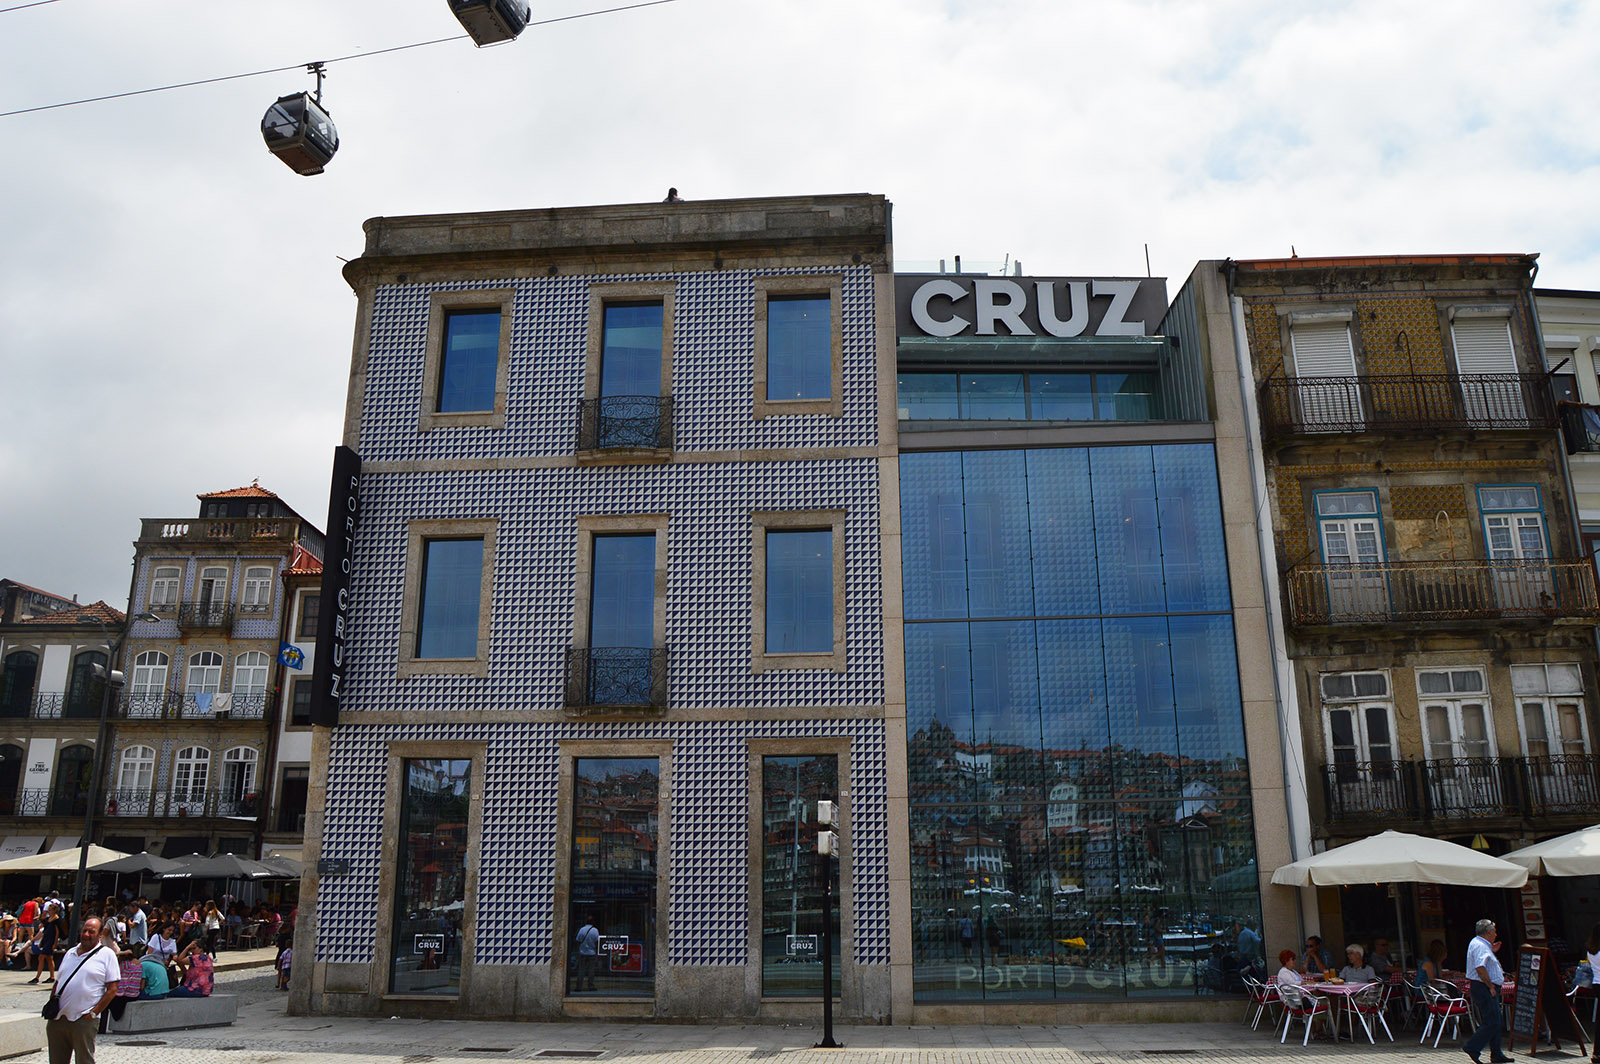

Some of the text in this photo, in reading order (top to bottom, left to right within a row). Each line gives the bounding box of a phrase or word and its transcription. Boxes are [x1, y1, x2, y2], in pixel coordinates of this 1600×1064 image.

[911, 279, 1145, 337] CRUZ
[331, 476, 358, 698] PORTO CRUZ
[790, 942, 813, 950] CRUZ
[955, 965, 1075, 990] PORTO
